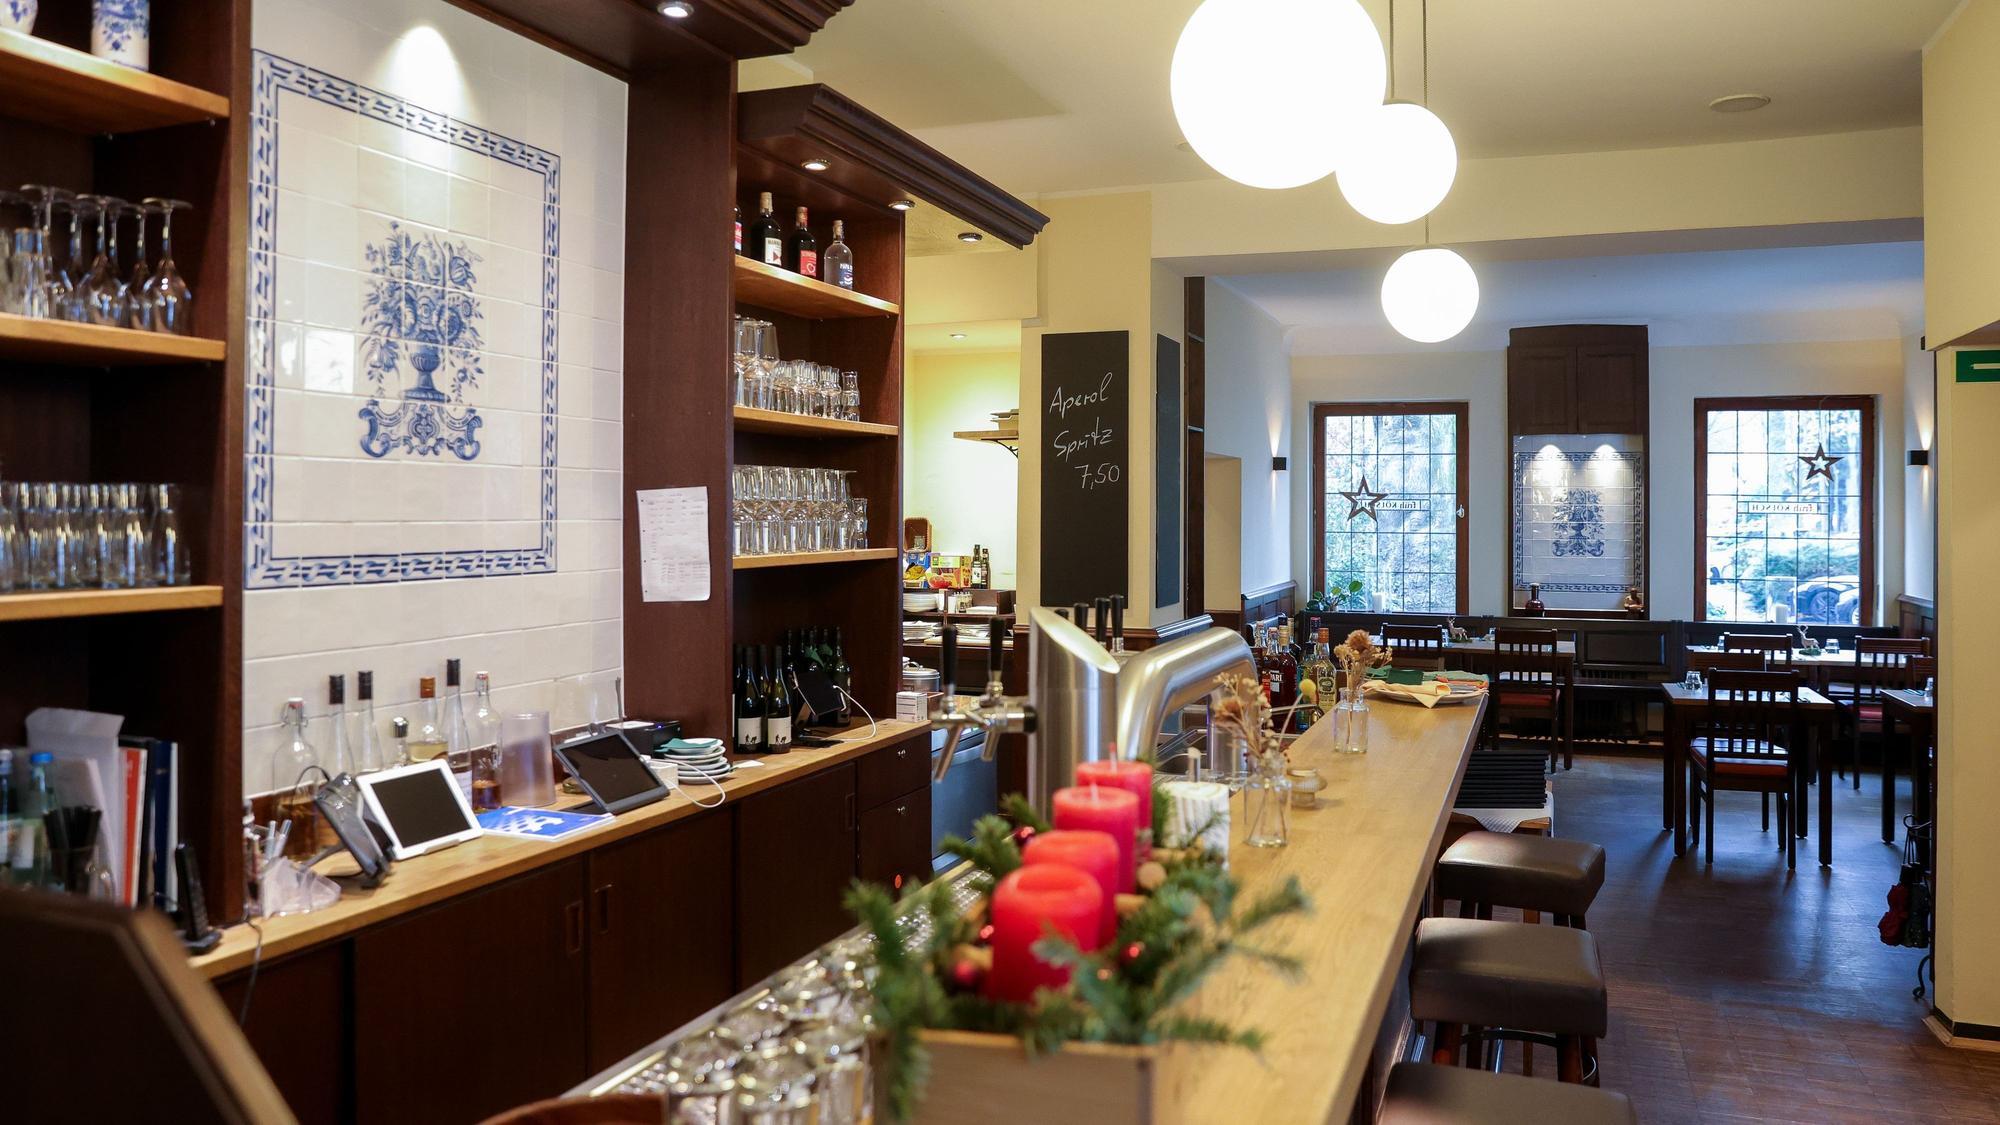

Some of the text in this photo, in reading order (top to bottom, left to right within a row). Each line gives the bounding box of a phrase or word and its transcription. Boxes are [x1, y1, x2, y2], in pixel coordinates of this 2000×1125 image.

[1049, 372, 1113, 419] Aperol
[1053, 416, 1113, 463] Spritz
[1074, 462, 1120, 490] 7,50
